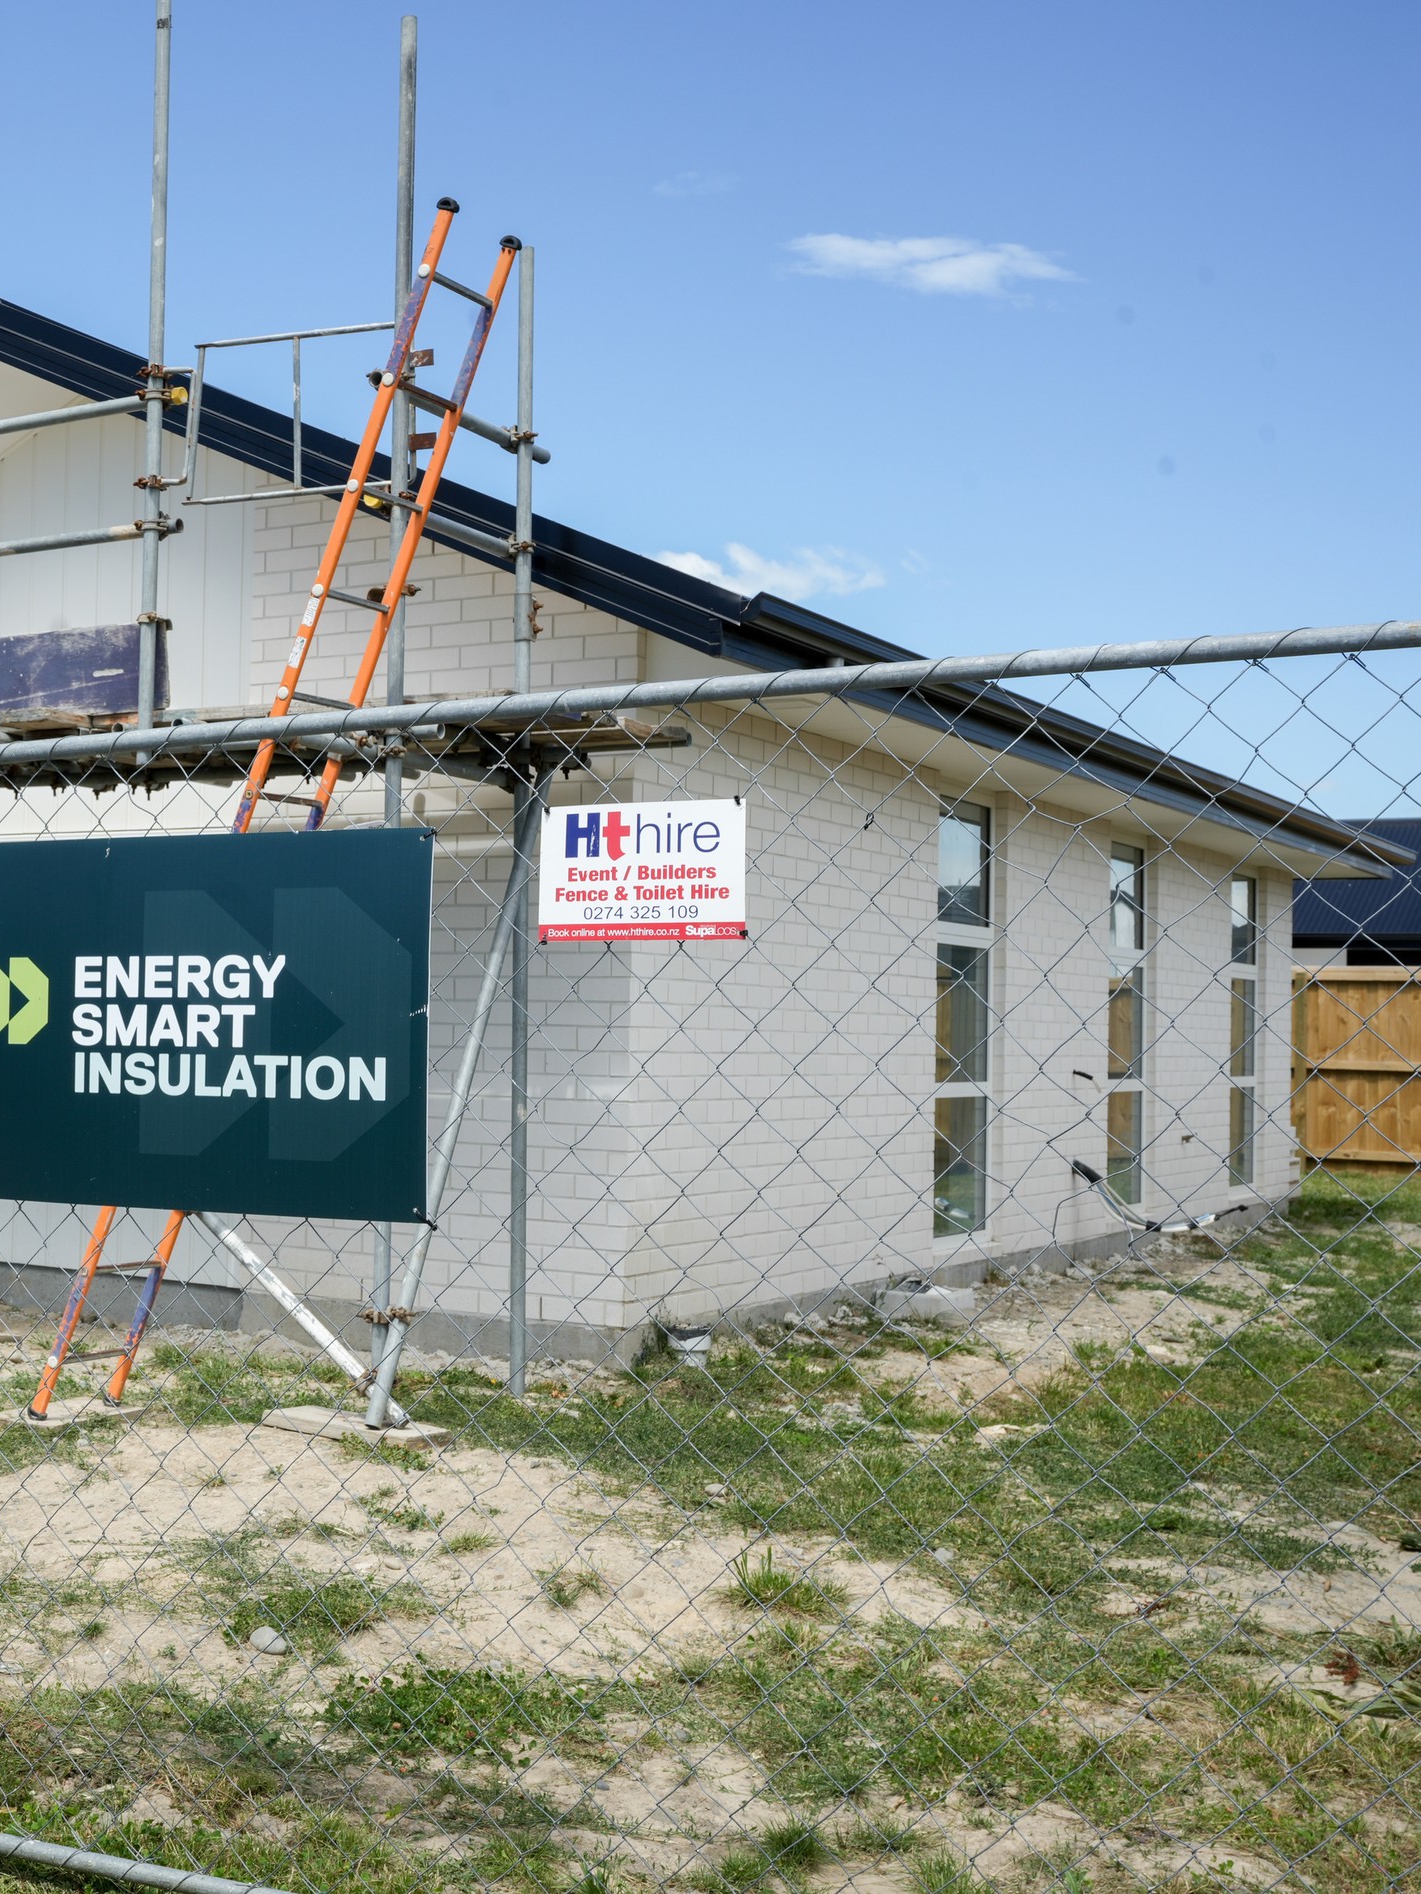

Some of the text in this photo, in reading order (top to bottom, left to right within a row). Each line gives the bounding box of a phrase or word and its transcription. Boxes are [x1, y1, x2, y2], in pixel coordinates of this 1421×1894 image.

[567, 864, 717, 882] Event / Builders
[555, 884, 730, 902] Fence & Toilet Hire
[583, 905, 699, 920] 0274 325 109
[548, 927, 680, 937] Book online at www.hthire.co.nz
[74, 954, 286, 998] ENERGY
[71, 1004, 255, 1048] SMART
[74, 1052, 387, 1101] INSULATION
